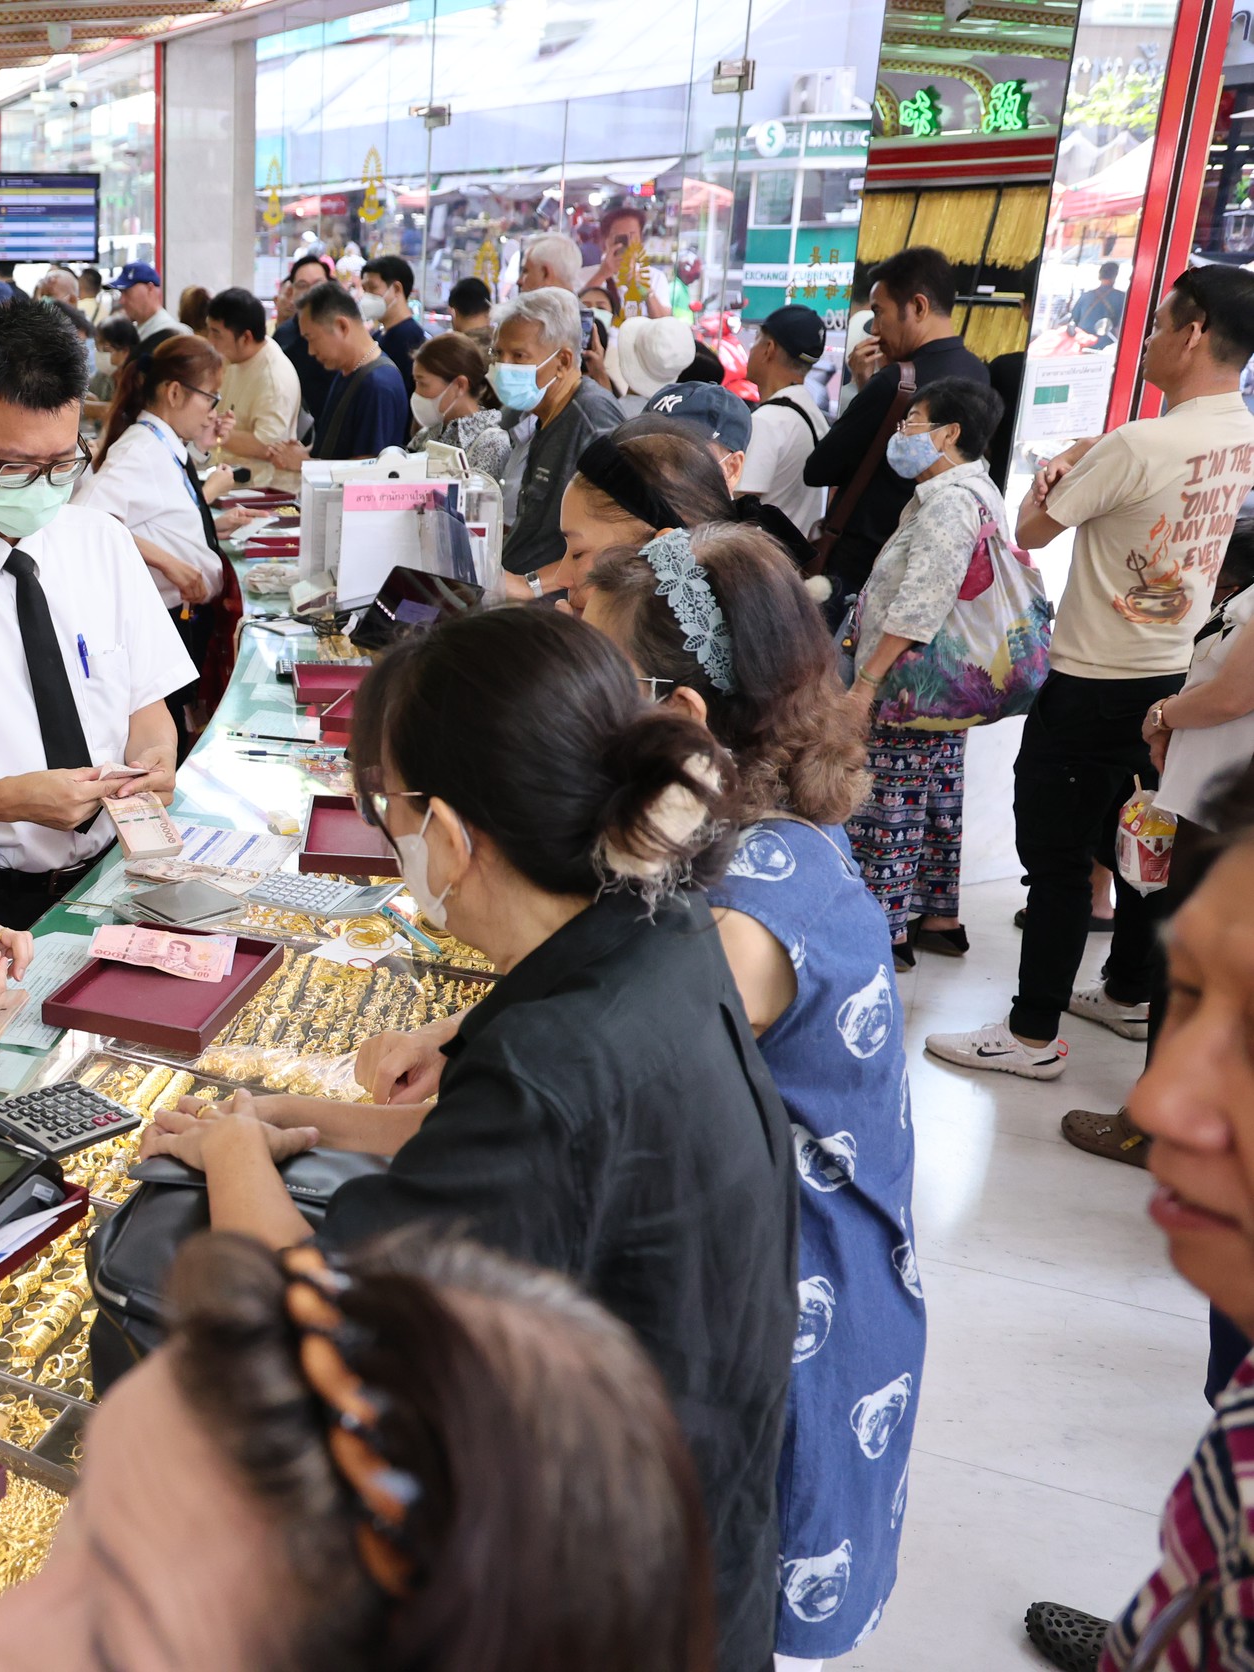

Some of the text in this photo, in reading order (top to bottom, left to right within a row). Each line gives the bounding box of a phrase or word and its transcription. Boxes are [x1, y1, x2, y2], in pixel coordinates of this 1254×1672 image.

[808, 130, 841, 147] MAX
[745, 270, 788, 281] EXCHANGE
[1184, 448, 1227, 486] I'M
[1181, 483, 1236, 520] ONLY
[1171, 517, 1205, 544] MY
[1182, 539, 1221, 571] EVER
[193, 970, 210, 979] 100
